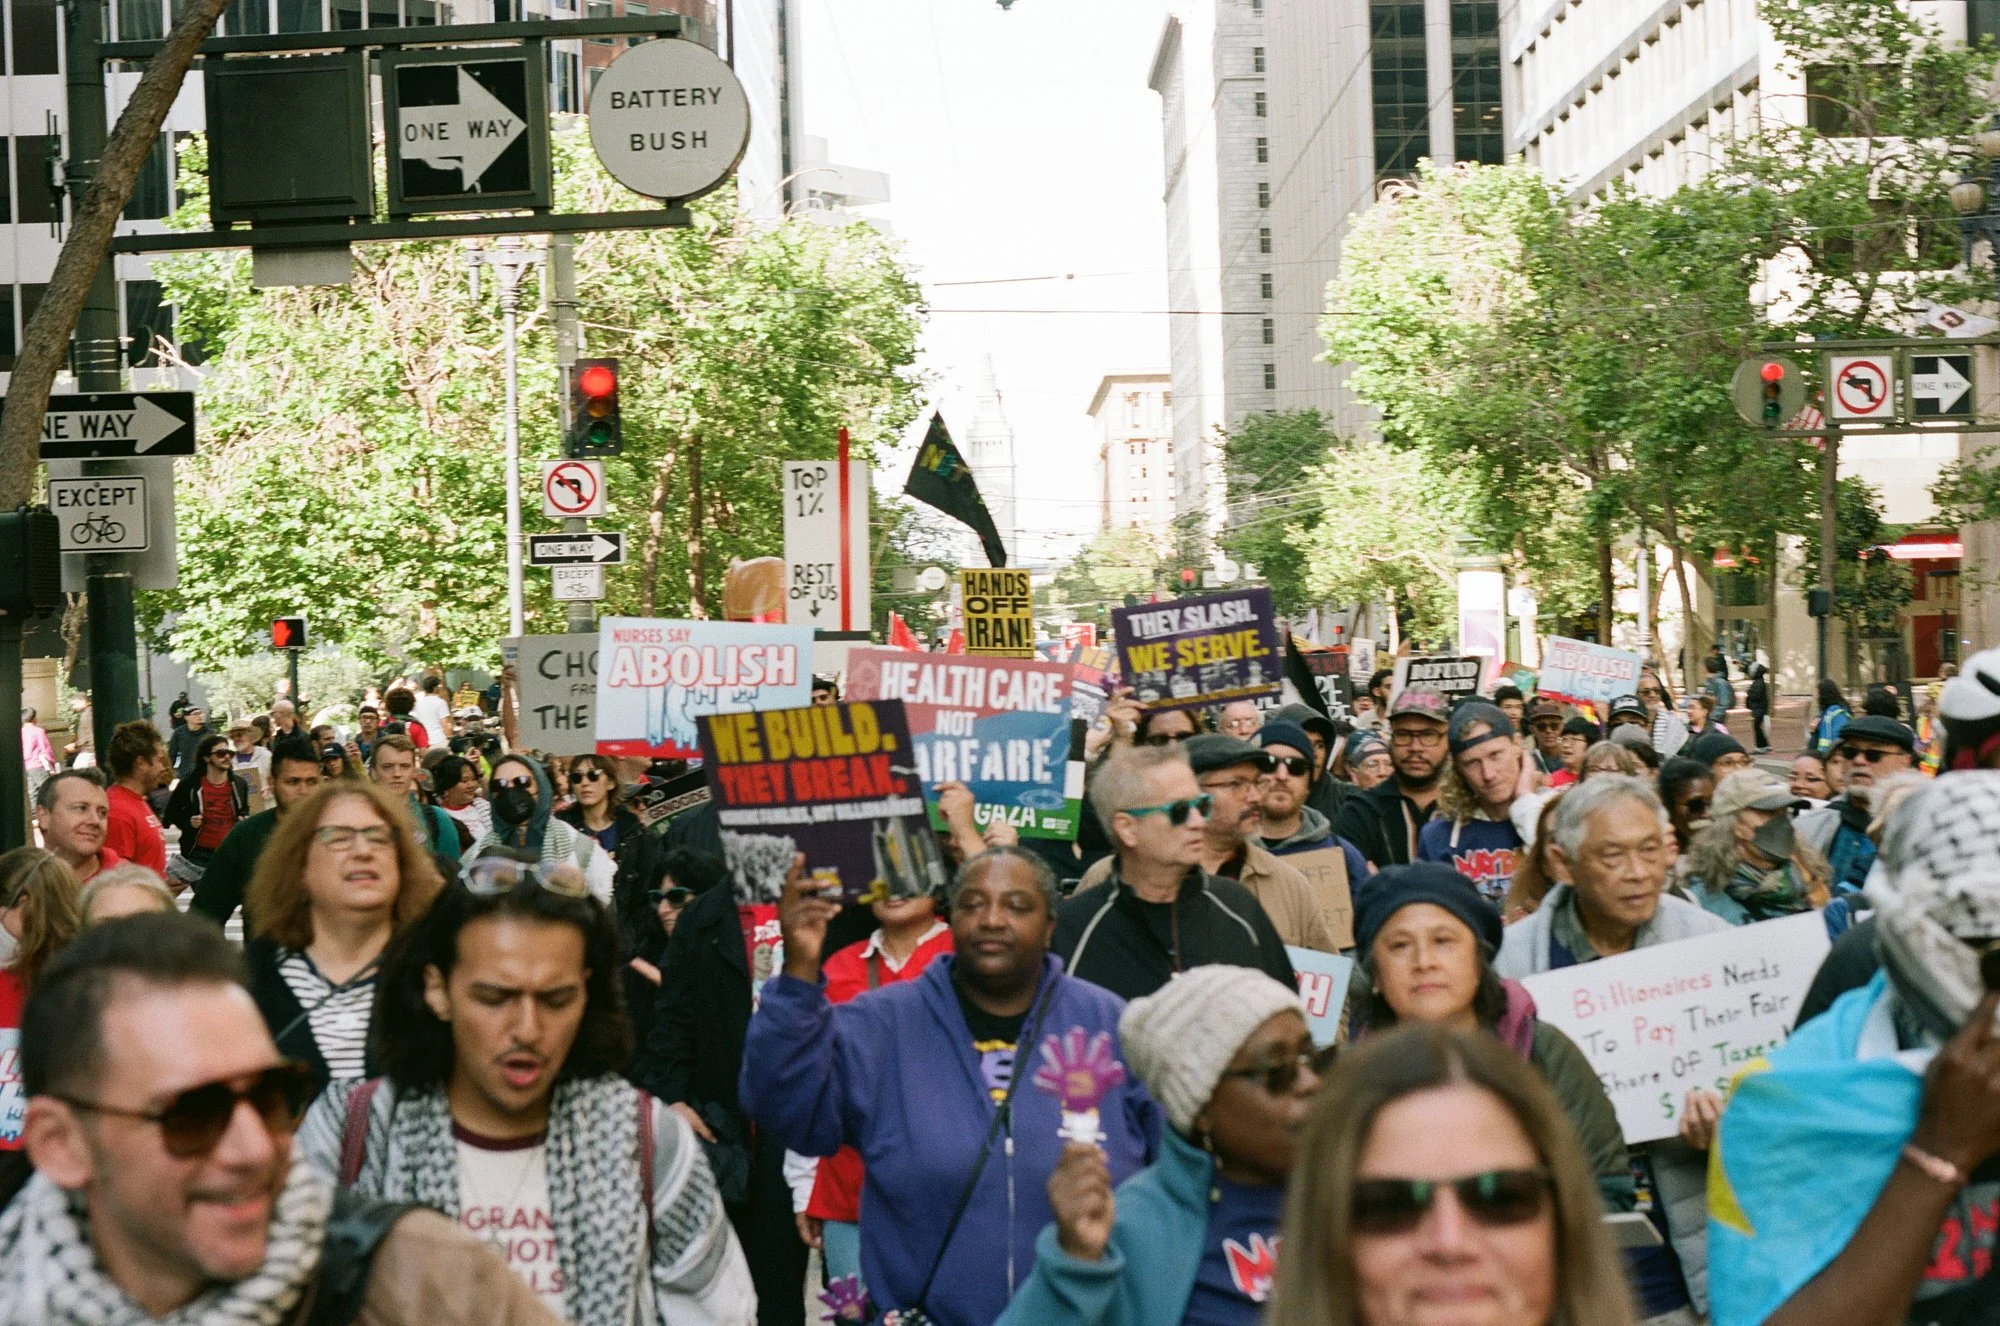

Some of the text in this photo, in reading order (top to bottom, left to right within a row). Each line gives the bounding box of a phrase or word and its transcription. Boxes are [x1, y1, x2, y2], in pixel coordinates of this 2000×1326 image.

[611, 86, 722, 110] BATTERY
[405, 119, 513, 142] ONE WAY
[630, 130, 708, 151] BUSH
[1913, 381, 1937, 391] ONE
[41, 413, 135, 439] NE WAY
[57, 487, 137, 507] EXCEPT
[796, 492, 824, 517] 1%
[538, 543, 594, 556] ONE WAY
[558, 569, 595, 580] EXCEPT
[793, 563, 835, 585] REST
[965, 572, 1028, 597] HANDS
[790, 585, 838, 601] OF US
[966, 596, 1029, 615] OFF
[1127, 607, 1181, 638] THEY
[1180, 599, 1259, 630] SLASH.
[612, 628, 692, 643] NURSES SAY
[967, 617, 1032, 648] IRAN!
[1127, 641, 1173, 674] WE
[1175, 628, 1270, 668] SERVE.
[607, 644, 798, 688] ABOLISH
[1548, 648, 1635, 681] ABOLISH
[571, 683, 597, 697] FRO
[533, 704, 589, 730] THE
[935, 709, 977, 737] NOT
[708, 702, 898, 764] WE BUILD.
[914, 738, 1053, 785] ARFARE
[717, 753, 909, 806] THEY BREAK.
[648, 789, 709, 820] GENOCIDE
[973, 802, 1037, 828] GAZA
[1573, 956, 1781, 1019] Billionaires Needs
[1582, 991, 1790, 1055] To Pay Their Fair
[506, 1238, 556, 1263] IOT
